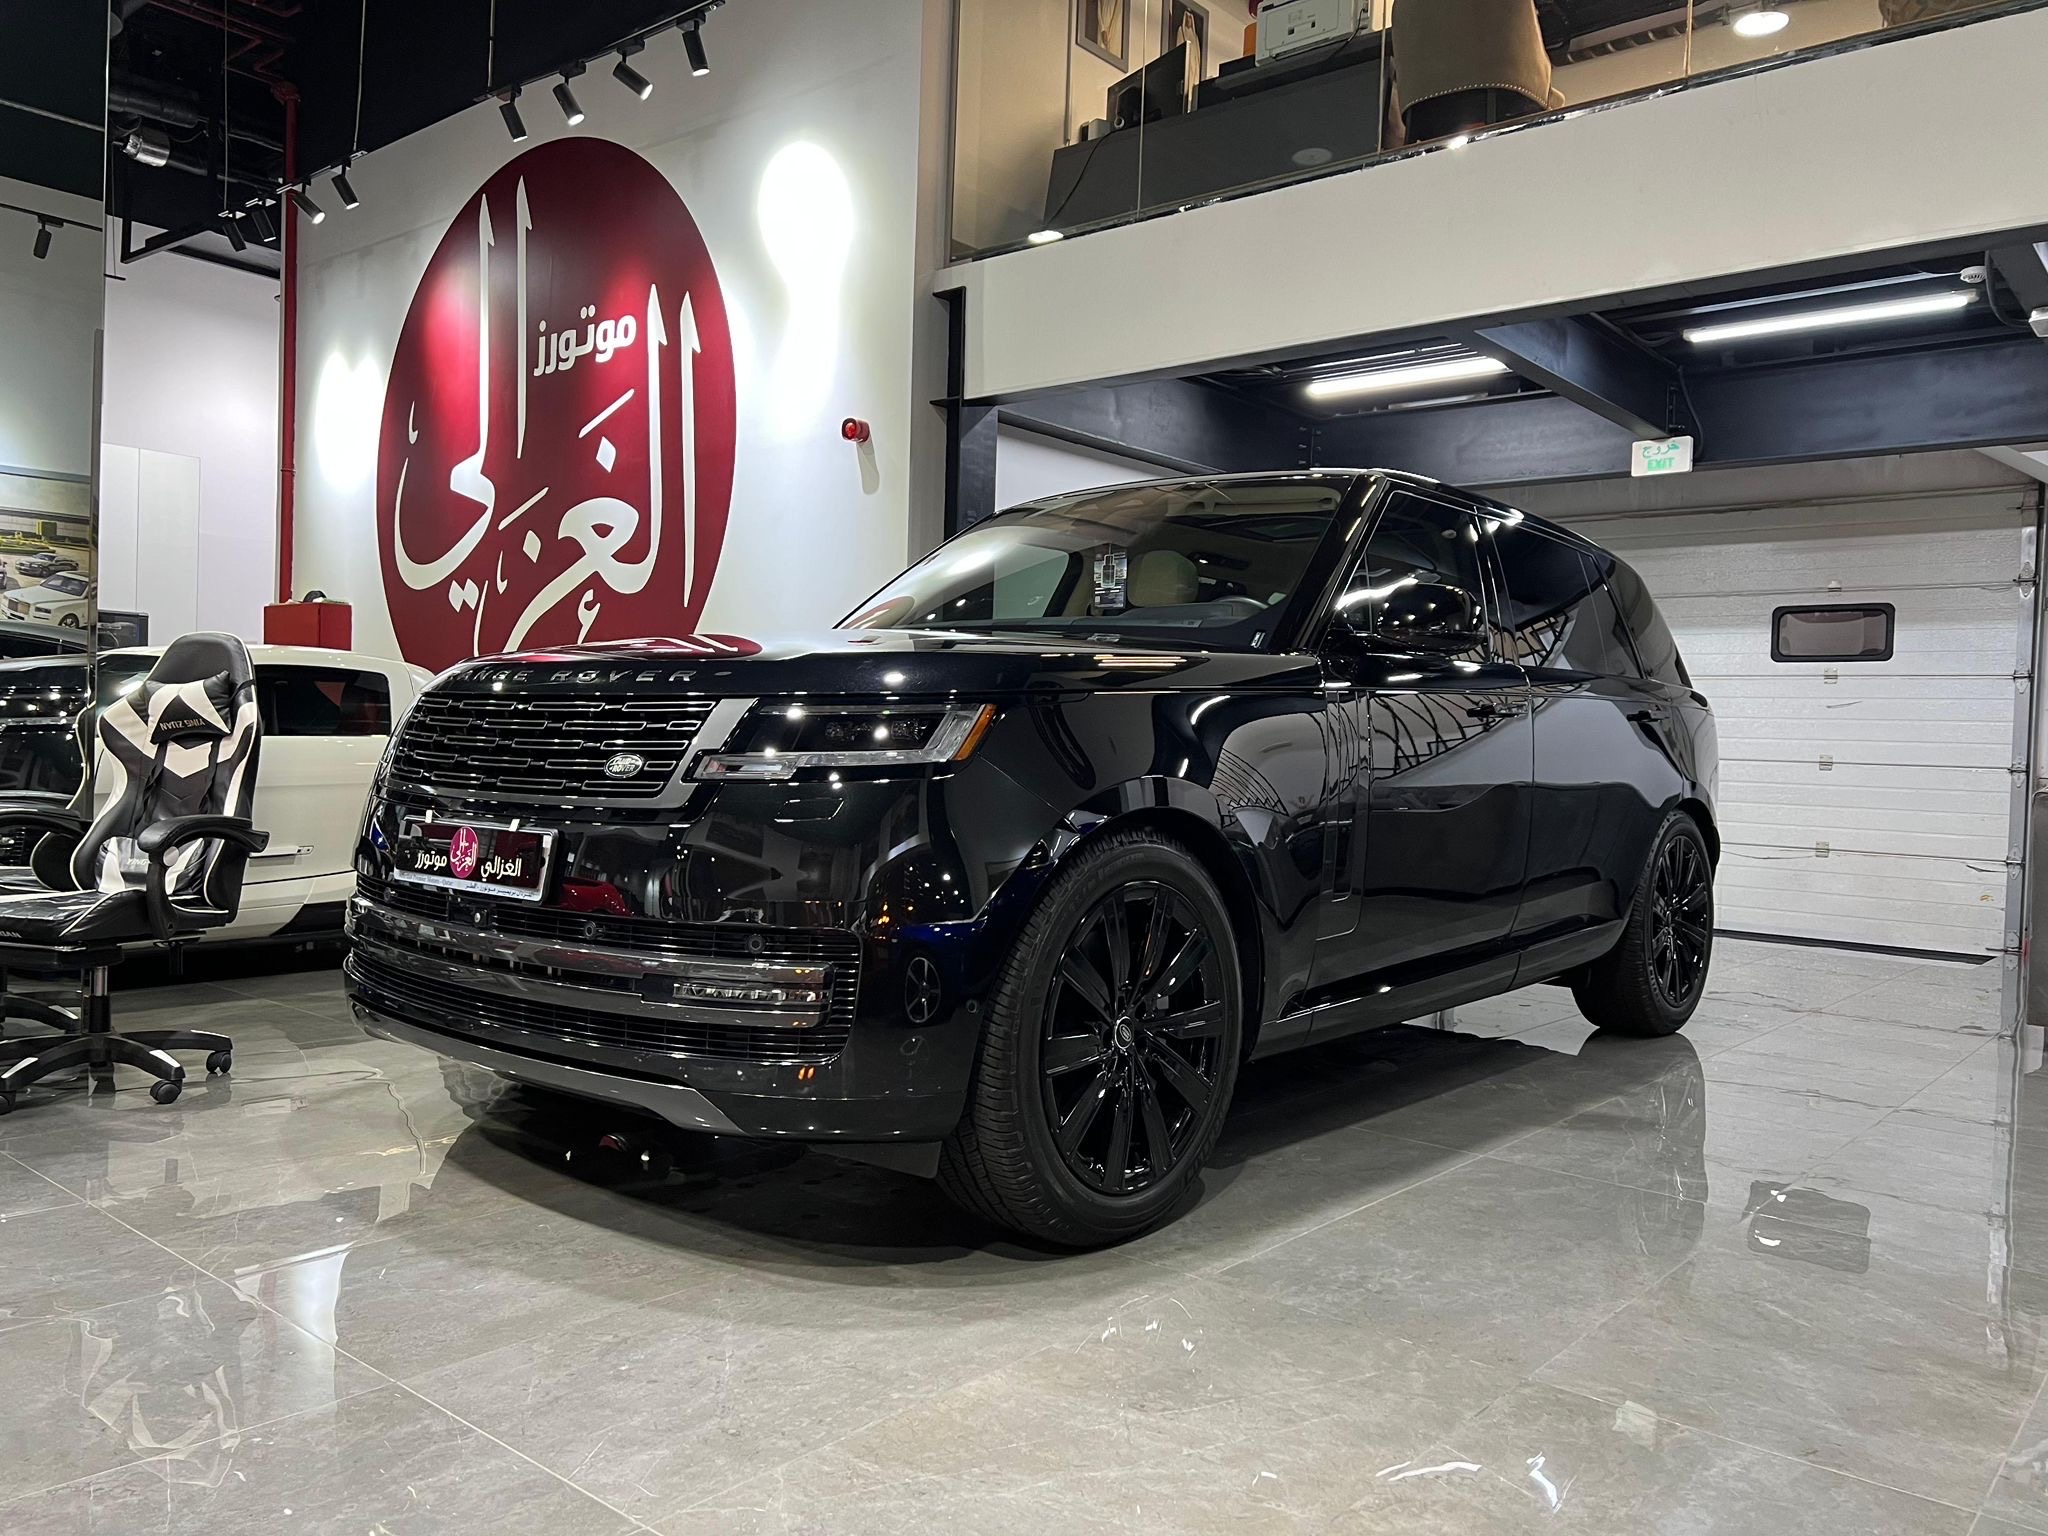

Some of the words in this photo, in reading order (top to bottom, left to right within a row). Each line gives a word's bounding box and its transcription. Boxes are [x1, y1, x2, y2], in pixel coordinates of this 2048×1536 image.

[533, 304, 638, 377] موتورز
[1642, 440, 1680, 459] خروج
[1647, 457, 1676, 472] EXIT
[549, 669, 697, 684] ROVER
[159, 720, 185, 731] ZUAN
[414, 849, 448, 871] موتورز
[480, 854, 523, 882] الغزالي
